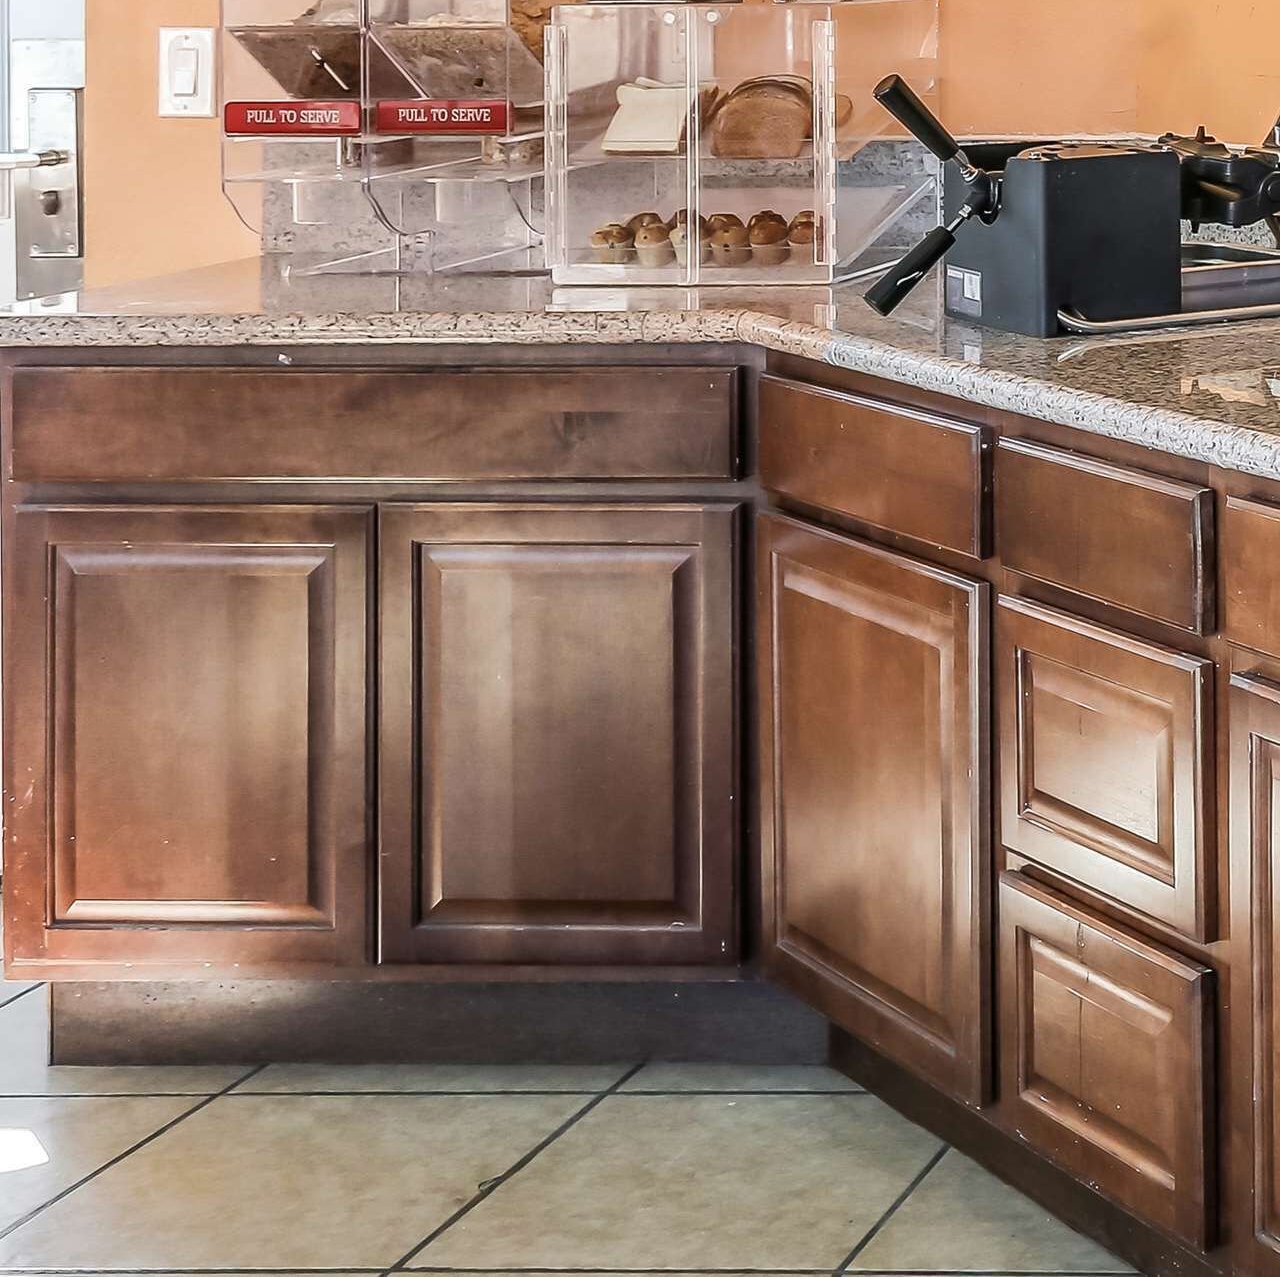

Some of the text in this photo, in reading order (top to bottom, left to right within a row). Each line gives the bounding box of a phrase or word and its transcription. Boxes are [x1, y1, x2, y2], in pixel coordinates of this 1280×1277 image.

[246, 109, 340, 123] PULL TO SERVE
[398, 108, 491, 122] PULL TO SERVE
